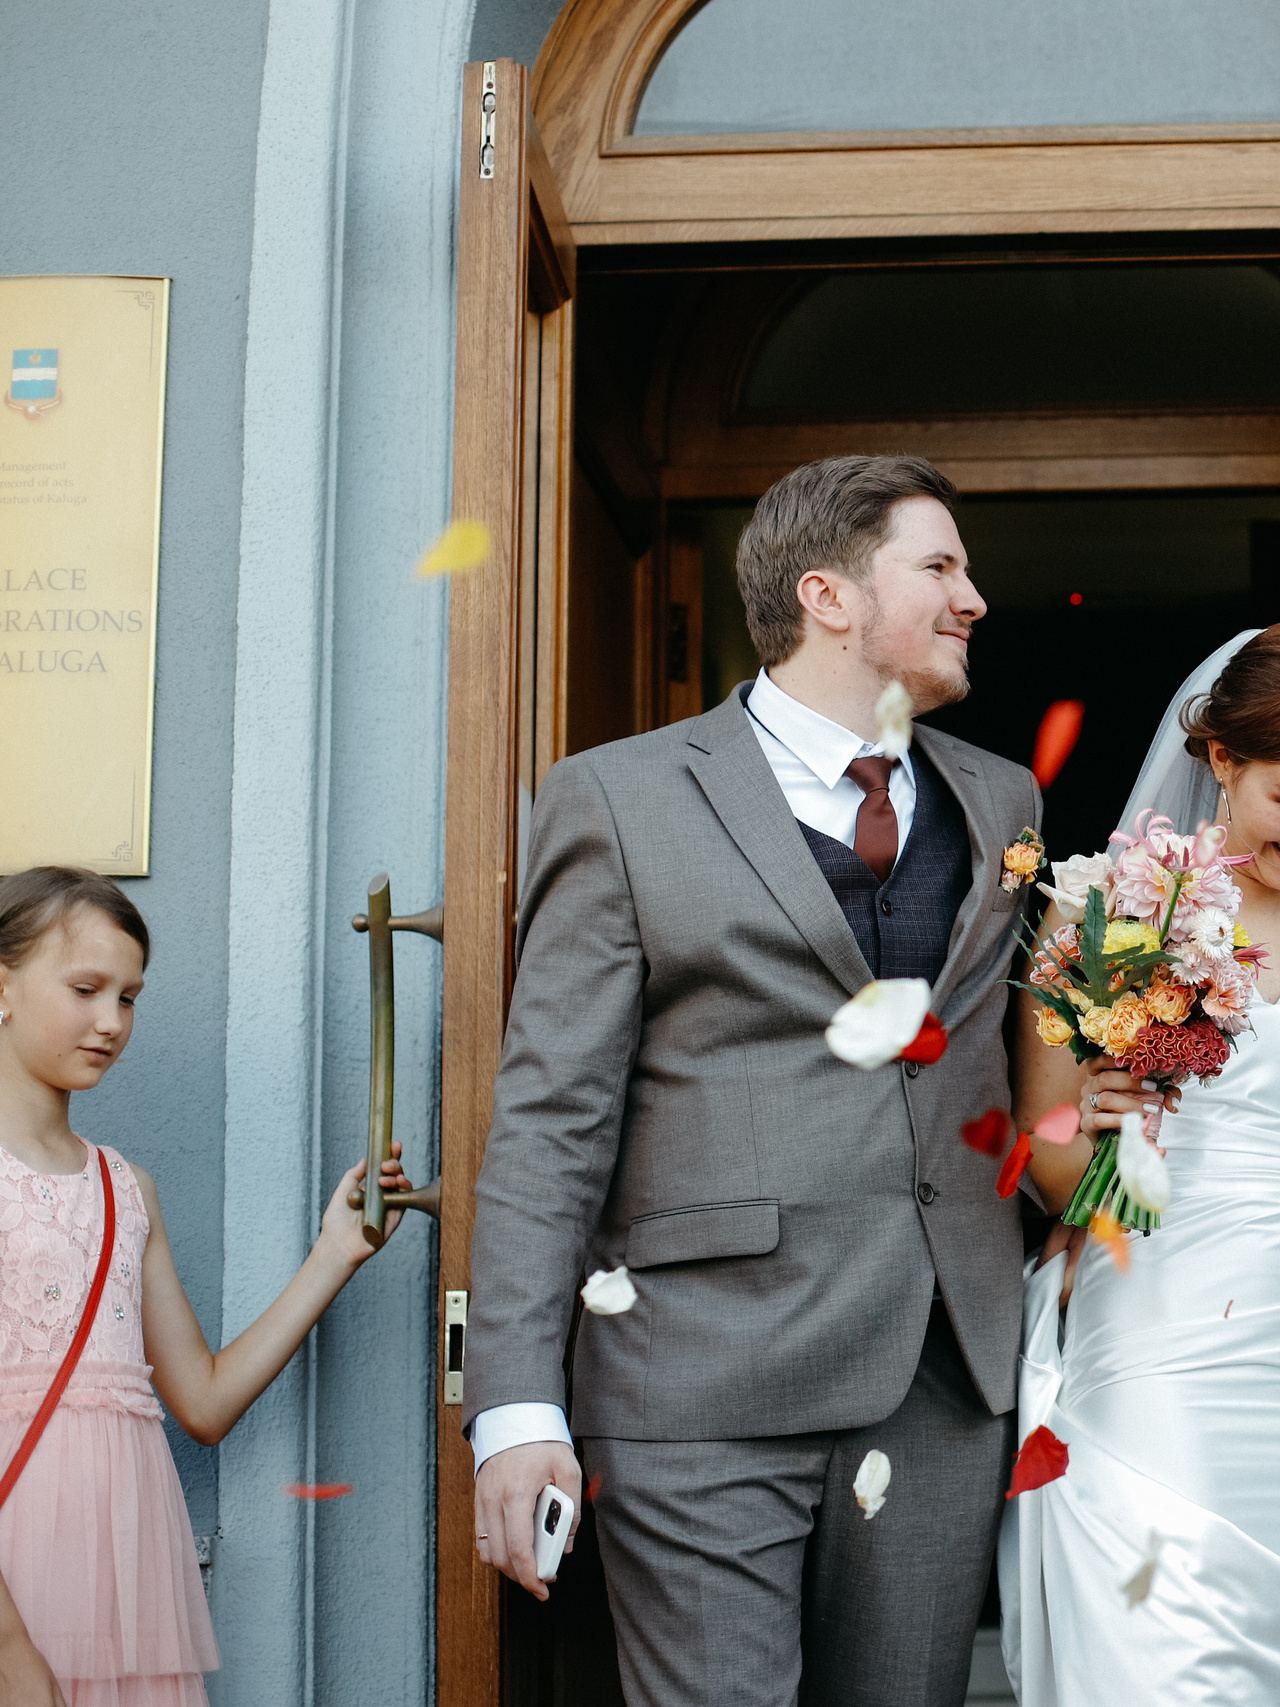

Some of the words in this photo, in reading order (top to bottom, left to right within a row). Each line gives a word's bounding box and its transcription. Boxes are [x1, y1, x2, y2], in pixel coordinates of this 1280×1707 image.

[37, 476, 50, 488] of
[51, 478, 74, 488] acts
[32, 493, 44, 504] of
[47, 493, 88, 507] Kaluga
[0, 567, 88, 592] LACE
[0, 608, 144, 633] RATIONS
